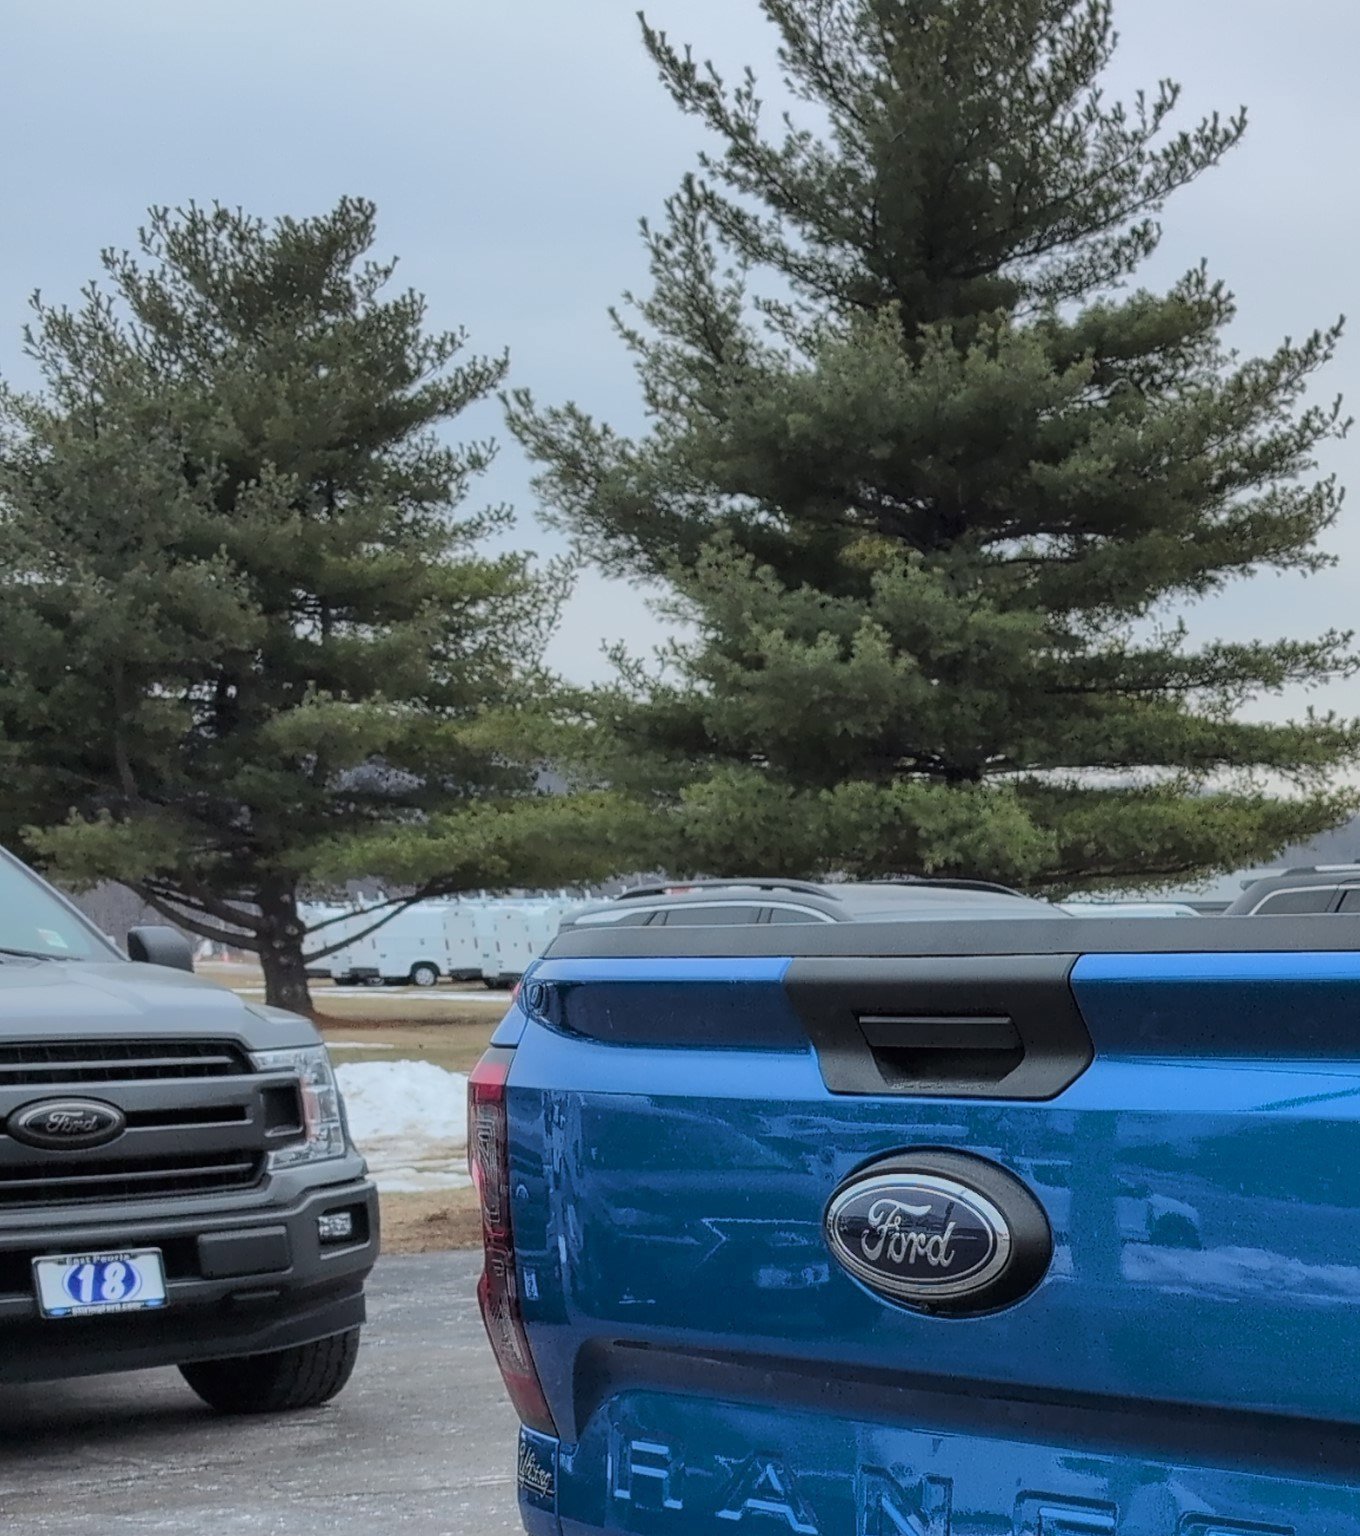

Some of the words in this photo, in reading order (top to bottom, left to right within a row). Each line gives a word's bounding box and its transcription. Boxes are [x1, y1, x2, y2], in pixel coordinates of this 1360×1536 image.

[45, 1111, 98, 1134] Ford
[861, 1198, 955, 1268] Ford
[76, 1261, 127, 1303] 18
